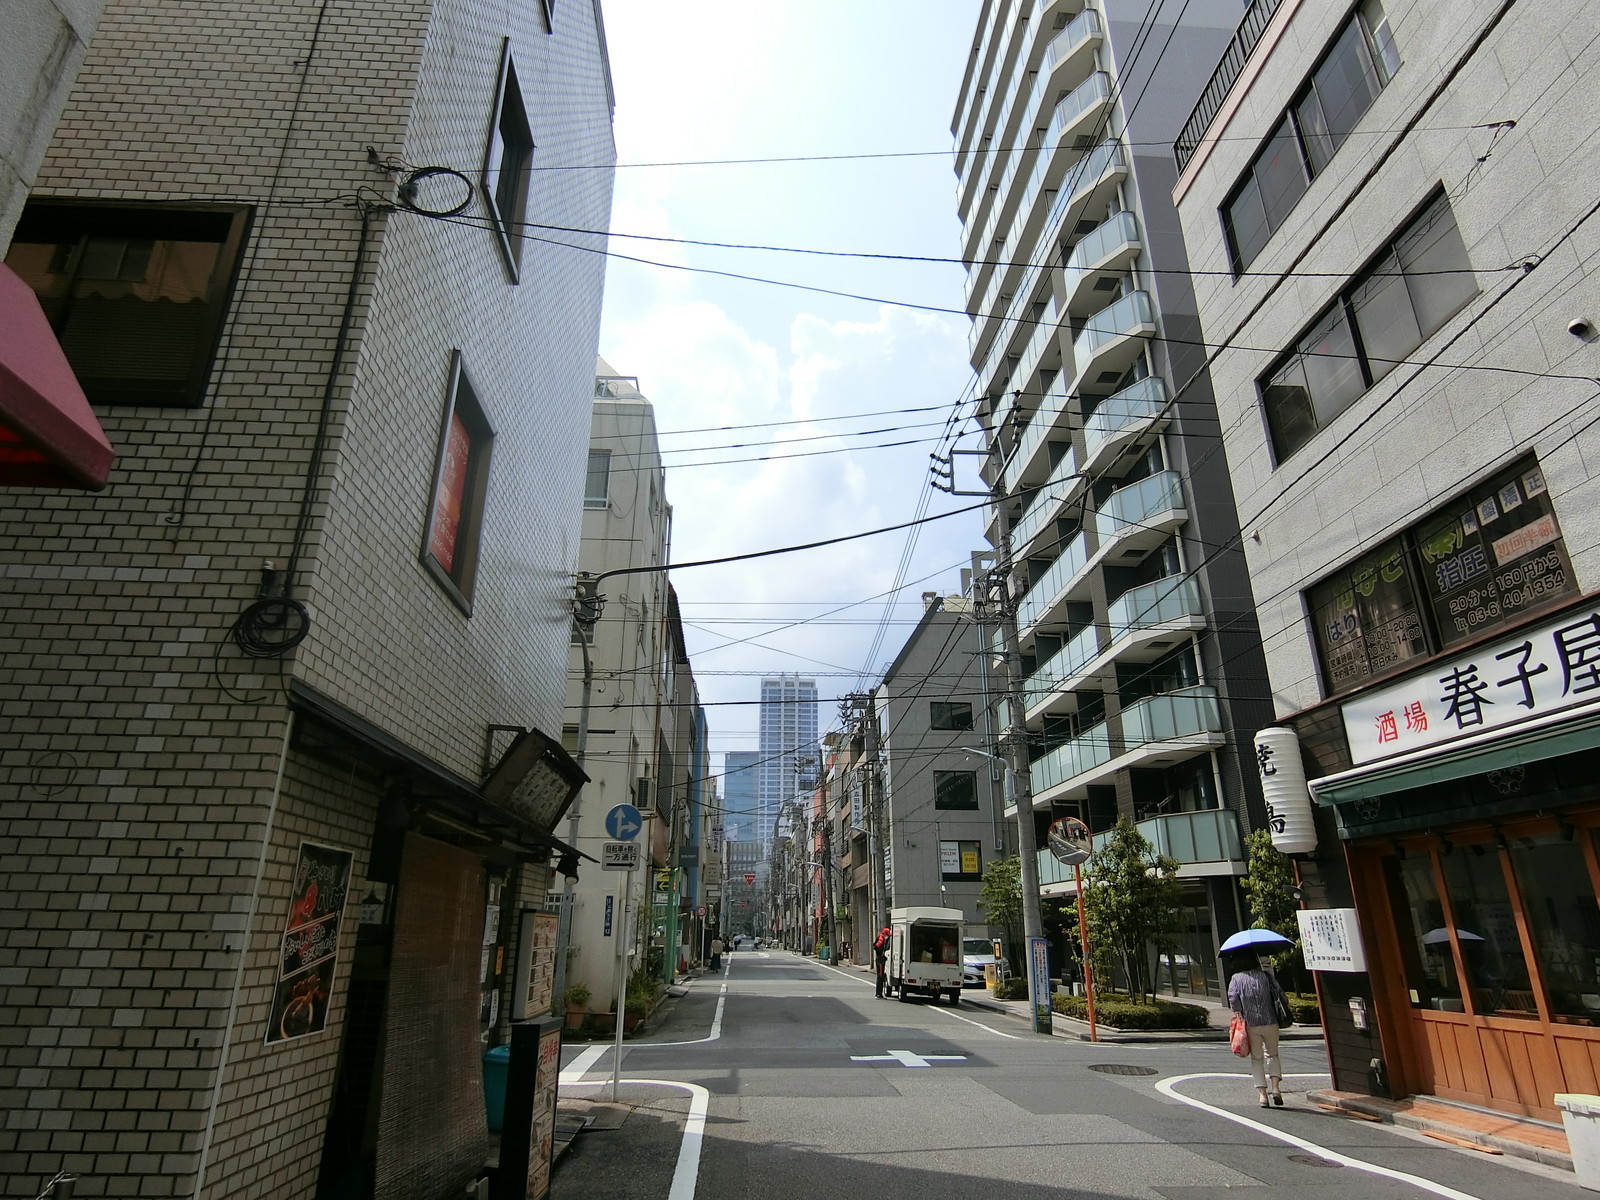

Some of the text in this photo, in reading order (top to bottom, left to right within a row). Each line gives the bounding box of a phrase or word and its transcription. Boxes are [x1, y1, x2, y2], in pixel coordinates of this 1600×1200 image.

[1495, 520, 1554, 558] 初回半額
[1436, 544, 1488, 592] 指圧
[1325, 613, 1357, 644] はり
[1374, 612, 1600, 744] 酒場 春子屋
[605, 853, 637, 861] 一方通行
[606, 845, 638, 853] 自転車を除く
